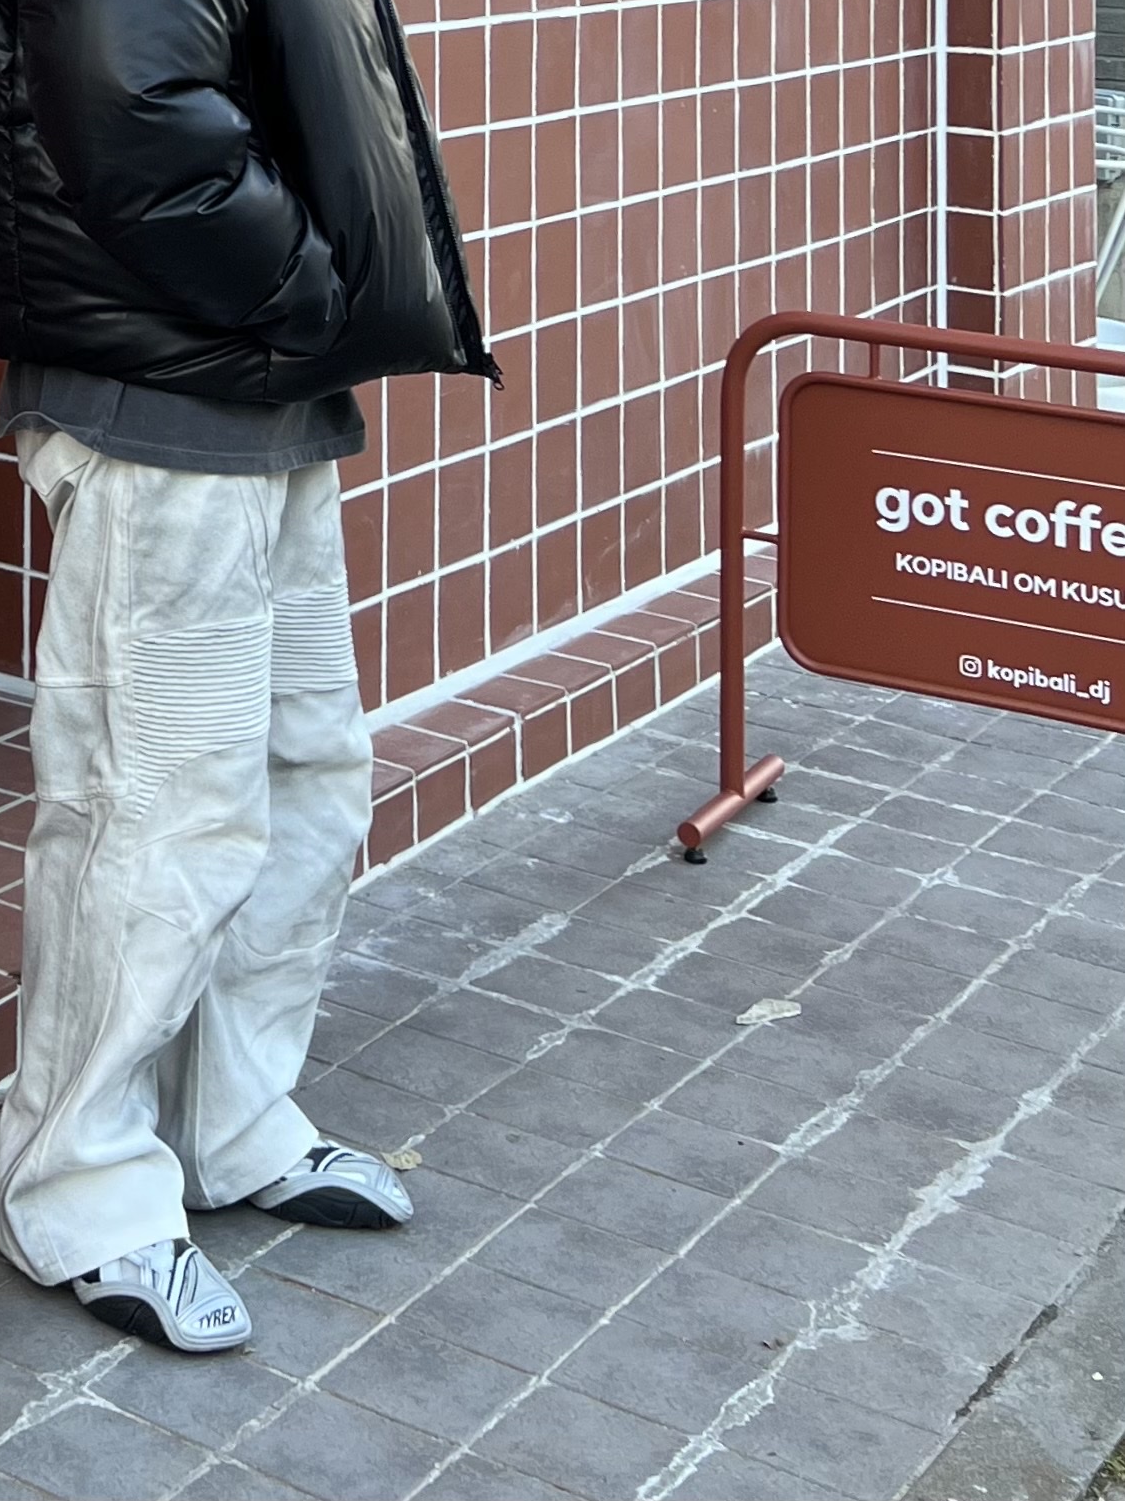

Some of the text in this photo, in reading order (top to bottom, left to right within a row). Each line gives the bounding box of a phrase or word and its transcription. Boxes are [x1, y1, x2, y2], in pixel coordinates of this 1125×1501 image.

[875, 486, 970, 532] got
[895, 552, 1008, 590] KOPIBALI
[1013, 573, 1057, 598] OM
[987, 659, 1111, 705] kopibali_dj
[198, 1305, 236, 1329] TYREX
